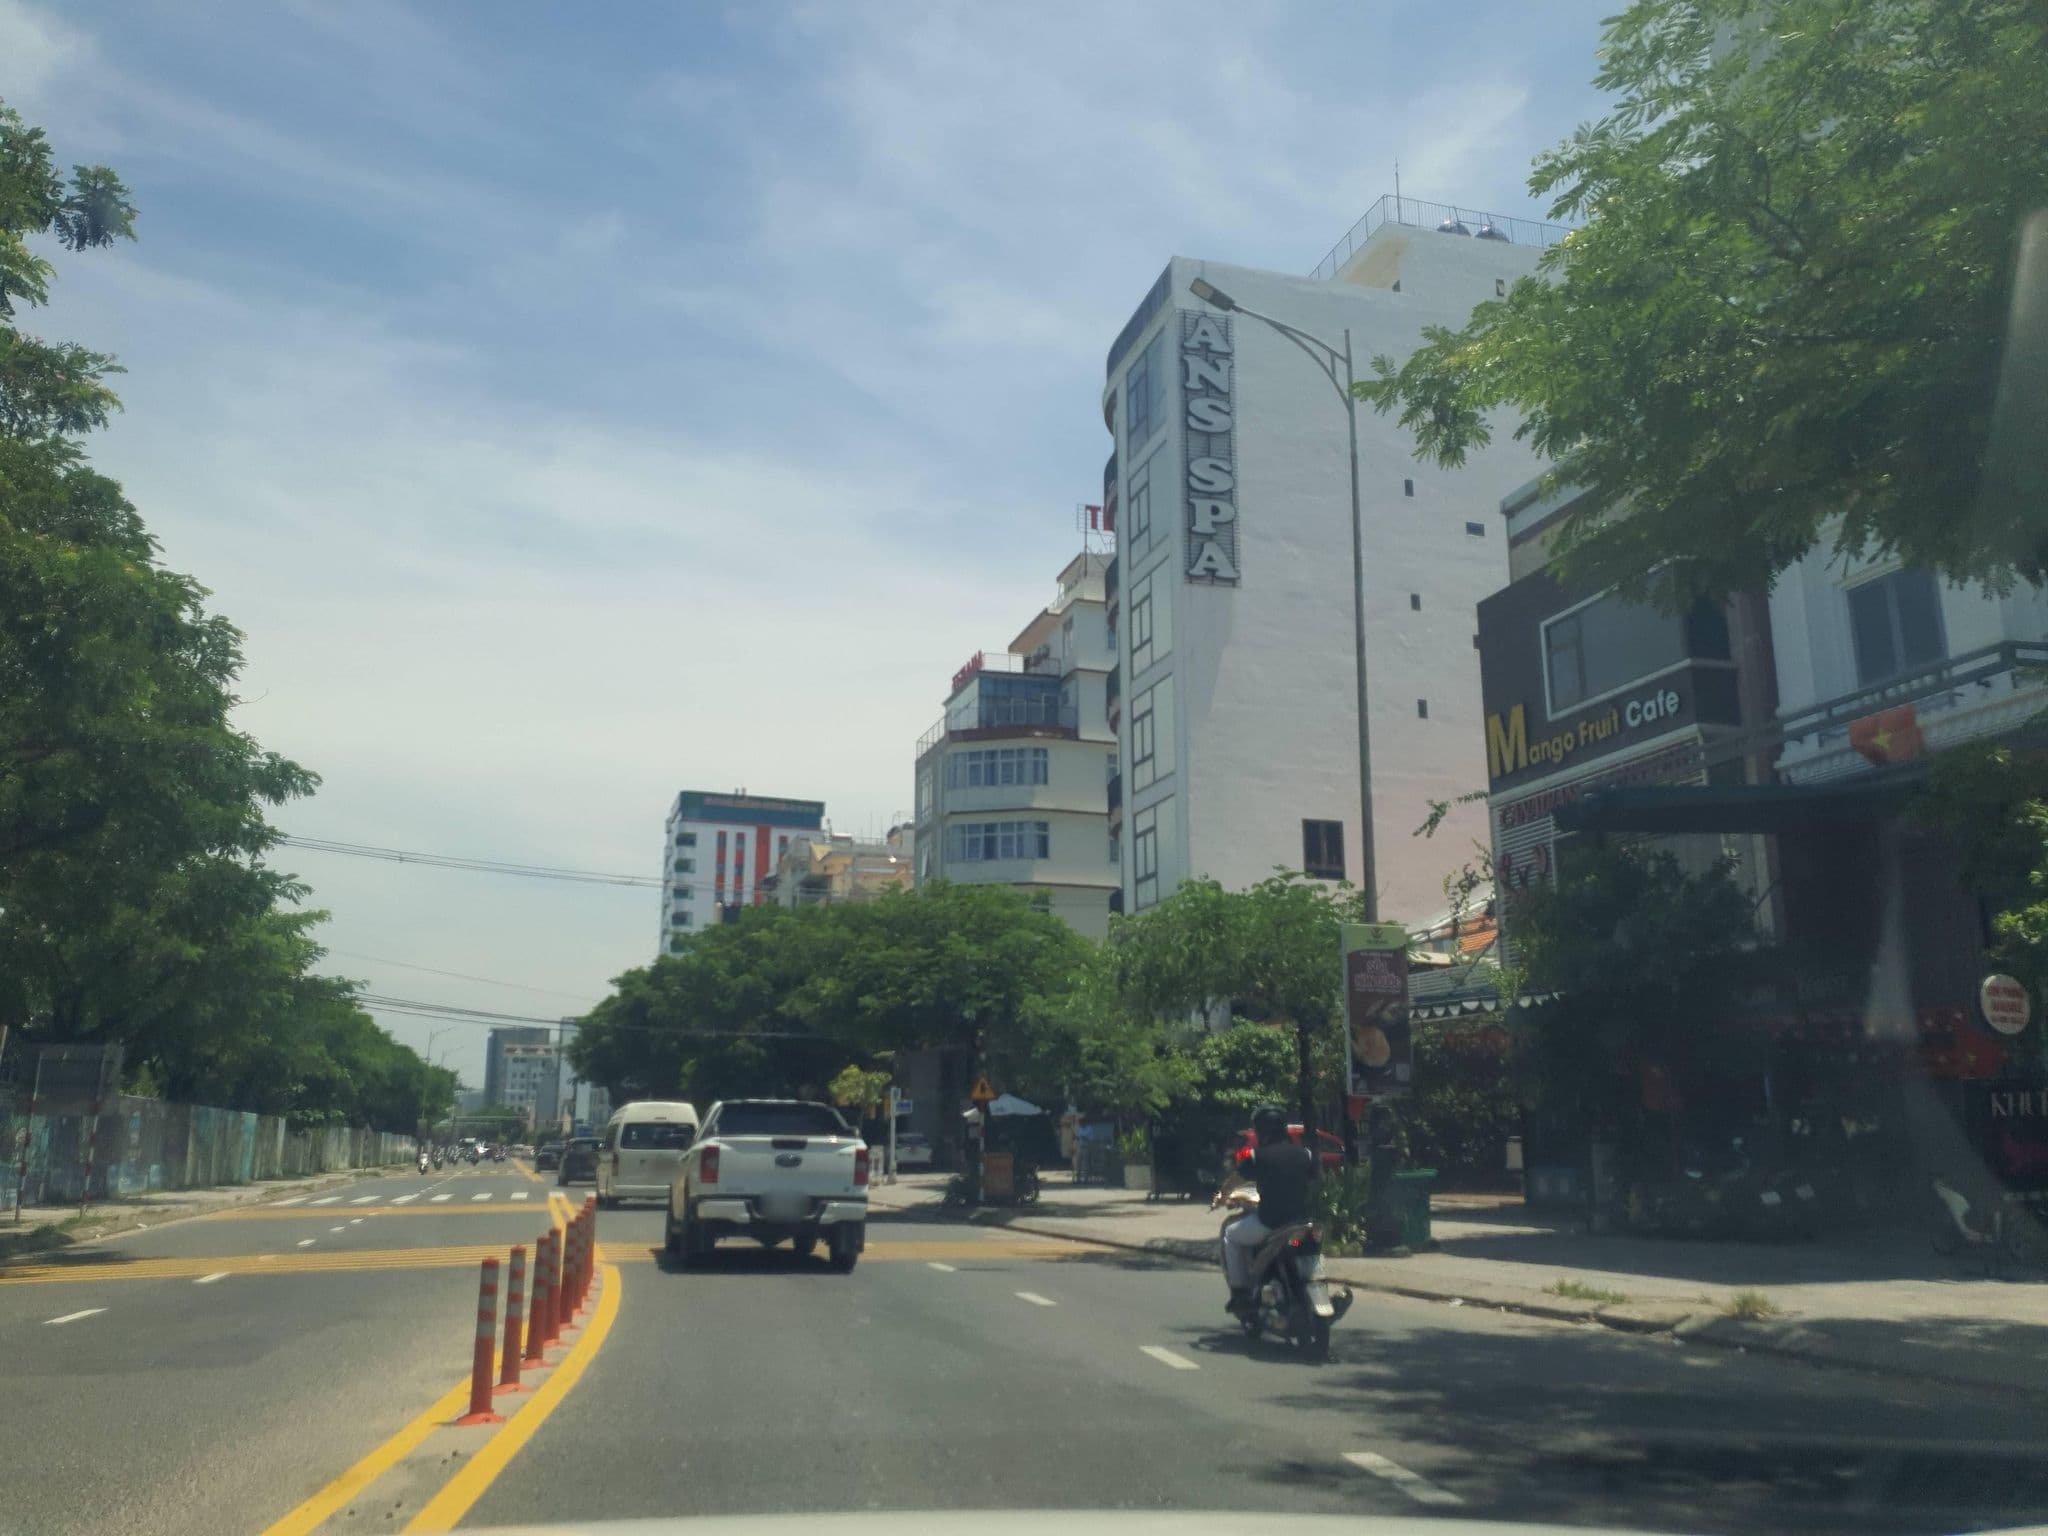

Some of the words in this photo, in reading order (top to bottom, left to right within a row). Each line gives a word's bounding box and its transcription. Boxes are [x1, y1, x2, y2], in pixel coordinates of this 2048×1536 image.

[1184, 314, 1234, 434] ANS
[1187, 455, 1241, 580] SPA
[1487, 703, 1576, 778] Mango
[1577, 706, 1620, 748] Fruit
[1625, 687, 1681, 728] Cafe
